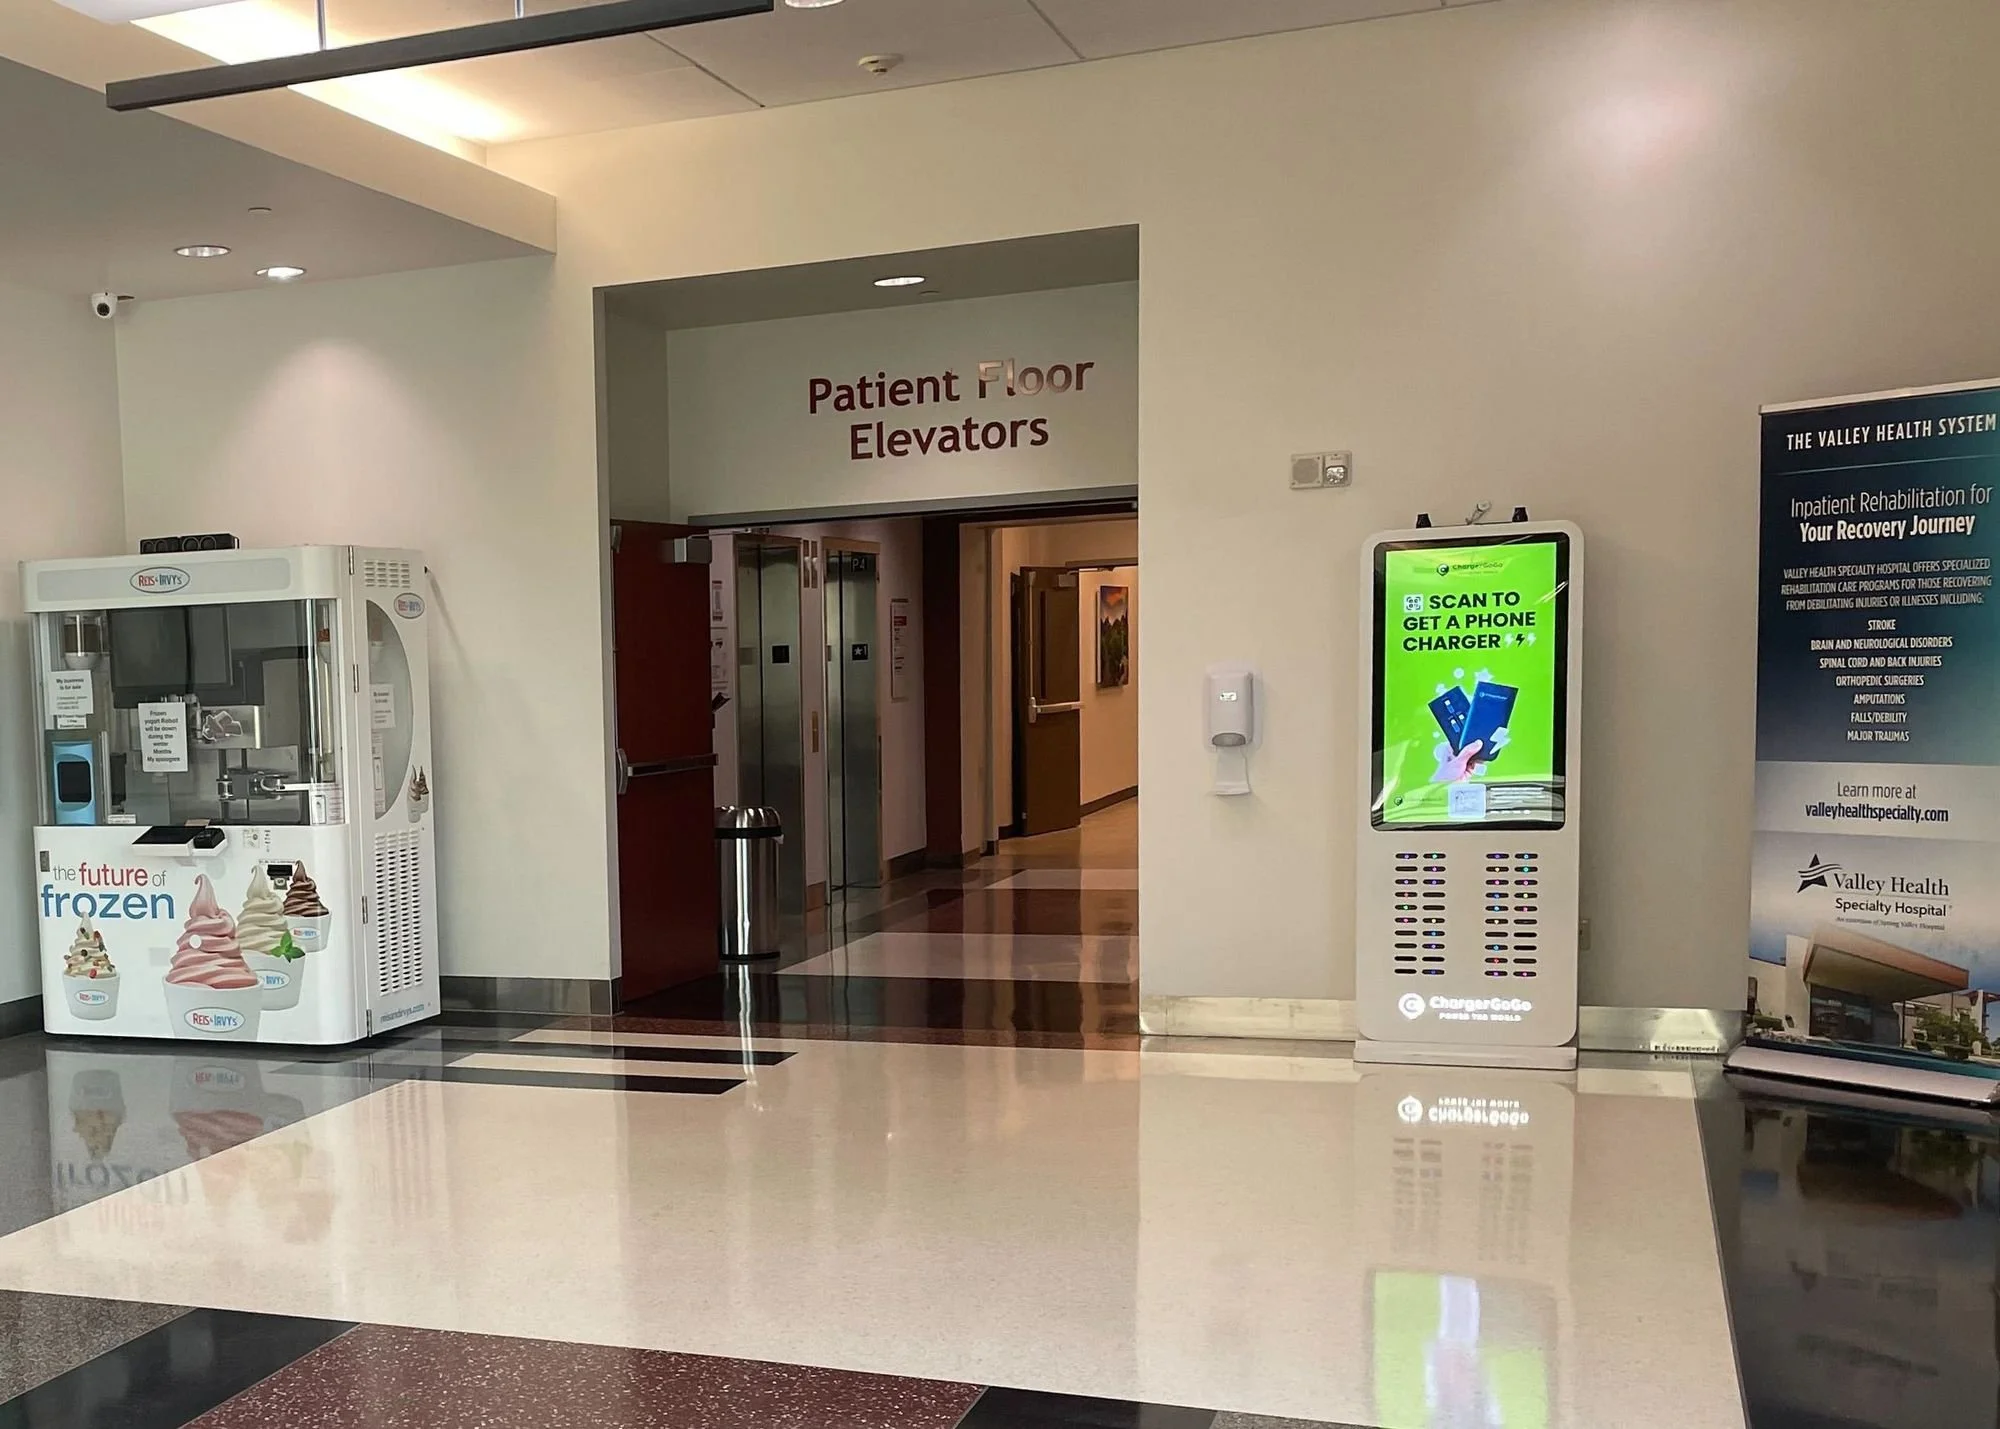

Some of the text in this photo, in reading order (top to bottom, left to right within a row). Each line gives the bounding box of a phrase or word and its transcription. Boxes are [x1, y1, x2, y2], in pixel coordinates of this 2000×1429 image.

[809, 358, 1095, 414] Patient Floor
[850, 416, 1049, 460] Elevators
[1787, 413, 1996, 450] THE VALLEY HEALTH SYSTEM
[1791, 483, 1993, 520] Inpatient Rehabilitation for
[1800, 515, 1976, 543] Your Recovery Journey
[1783, 558, 1990, 579] VALLEY HEALTH SPECIALTY HOSPITAL OFFERS SPECIALIZED
[1781, 575, 1992, 595] REHABILITATION CARE PROGRAMS FOR THOSE RECOVERING
[1429, 591, 1520, 609] SCAN TO
[1786, 592, 1984, 611] FROM DEBILITATING INJURIES OR ILLNESSES INCLUDING:
[1403, 611, 1536, 631] GET A PHONE
[1867, 619, 1897, 631] STROKE
[1402, 634, 1501, 652] CHARGER
[1810, 636, 1953, 651] BRAIN AND NEUROLOGICAL DISORDERS
[1819, 655, 1942, 669] SPINAL CORD AND BACK INJURIES
[1835, 674, 1924, 687] ORTHOPEDIC SURGERIES
[1853, 693, 1905, 705] AMPUTATIONS
[1850, 712, 1907, 723] FALLS/DEBILITY
[1847, 730, 1910, 742] MAJOR TRAUMAS
[1837, 781, 1916, 800] Learn more at
[1805, 801, 1949, 823] valleyhealthspecialty.com
[52, 862, 167, 887] the future of
[1833, 873, 1949, 897] Valley Health
[40, 884, 175, 919] frozen
[1835, 898, 1947, 918] Specialty Hospital
[1429, 995, 1532, 1012] ChargerGoGo
[192, 1012, 210, 1026] REIS
